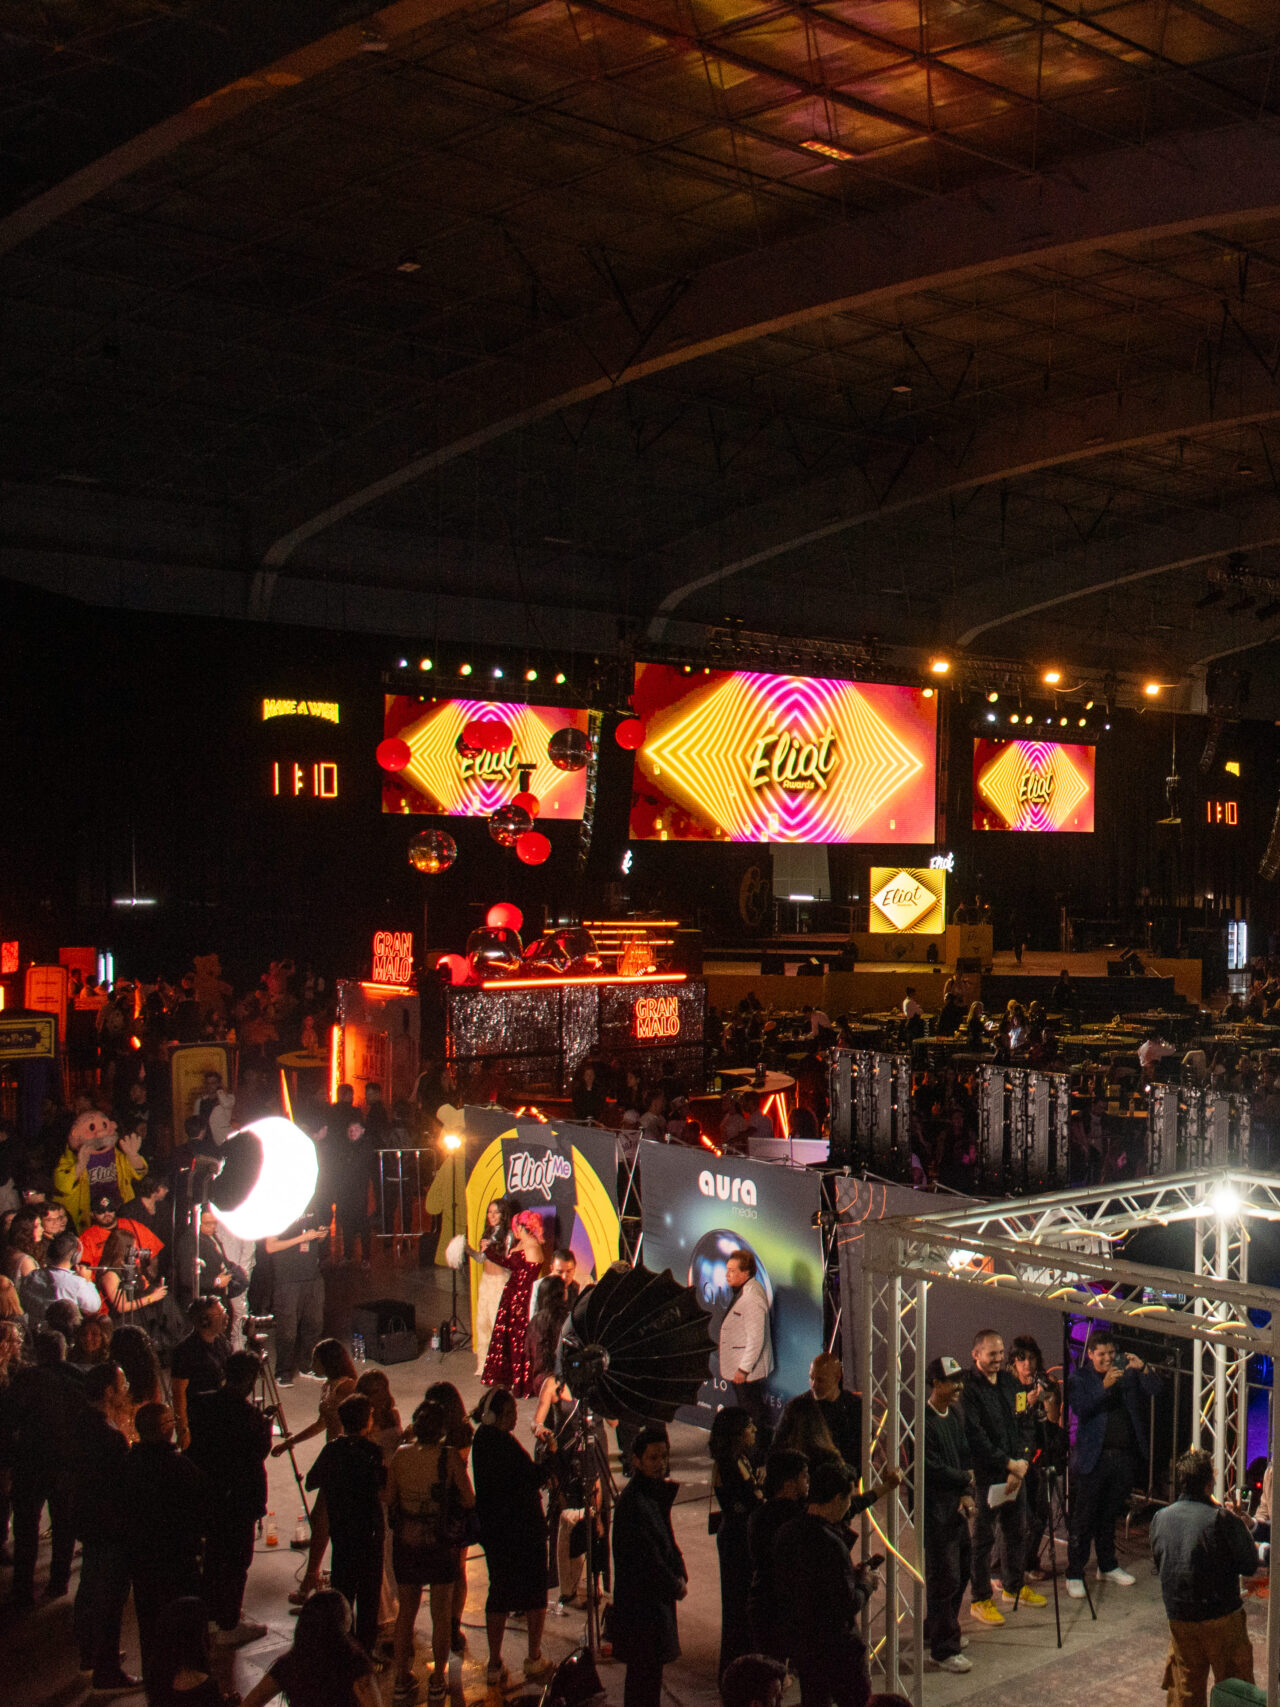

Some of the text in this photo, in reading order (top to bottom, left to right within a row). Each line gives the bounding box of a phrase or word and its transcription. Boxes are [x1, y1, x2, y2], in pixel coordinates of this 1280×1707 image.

[297, 701, 309, 715] A
[749, 725, 837, 790] Eliot
[783, 779, 815, 789] Awards
[1019, 767, 1054, 803] Eliot
[882, 885, 922, 907] Eliot
[373, 931, 413, 957] GRAN
[372, 955, 412, 982] MALO
[635, 996, 679, 1019] GRAN
[637, 1015, 681, 1038] MALO
[698, 1169, 757, 1207] aura
[731, 1205, 758, 1220] media
